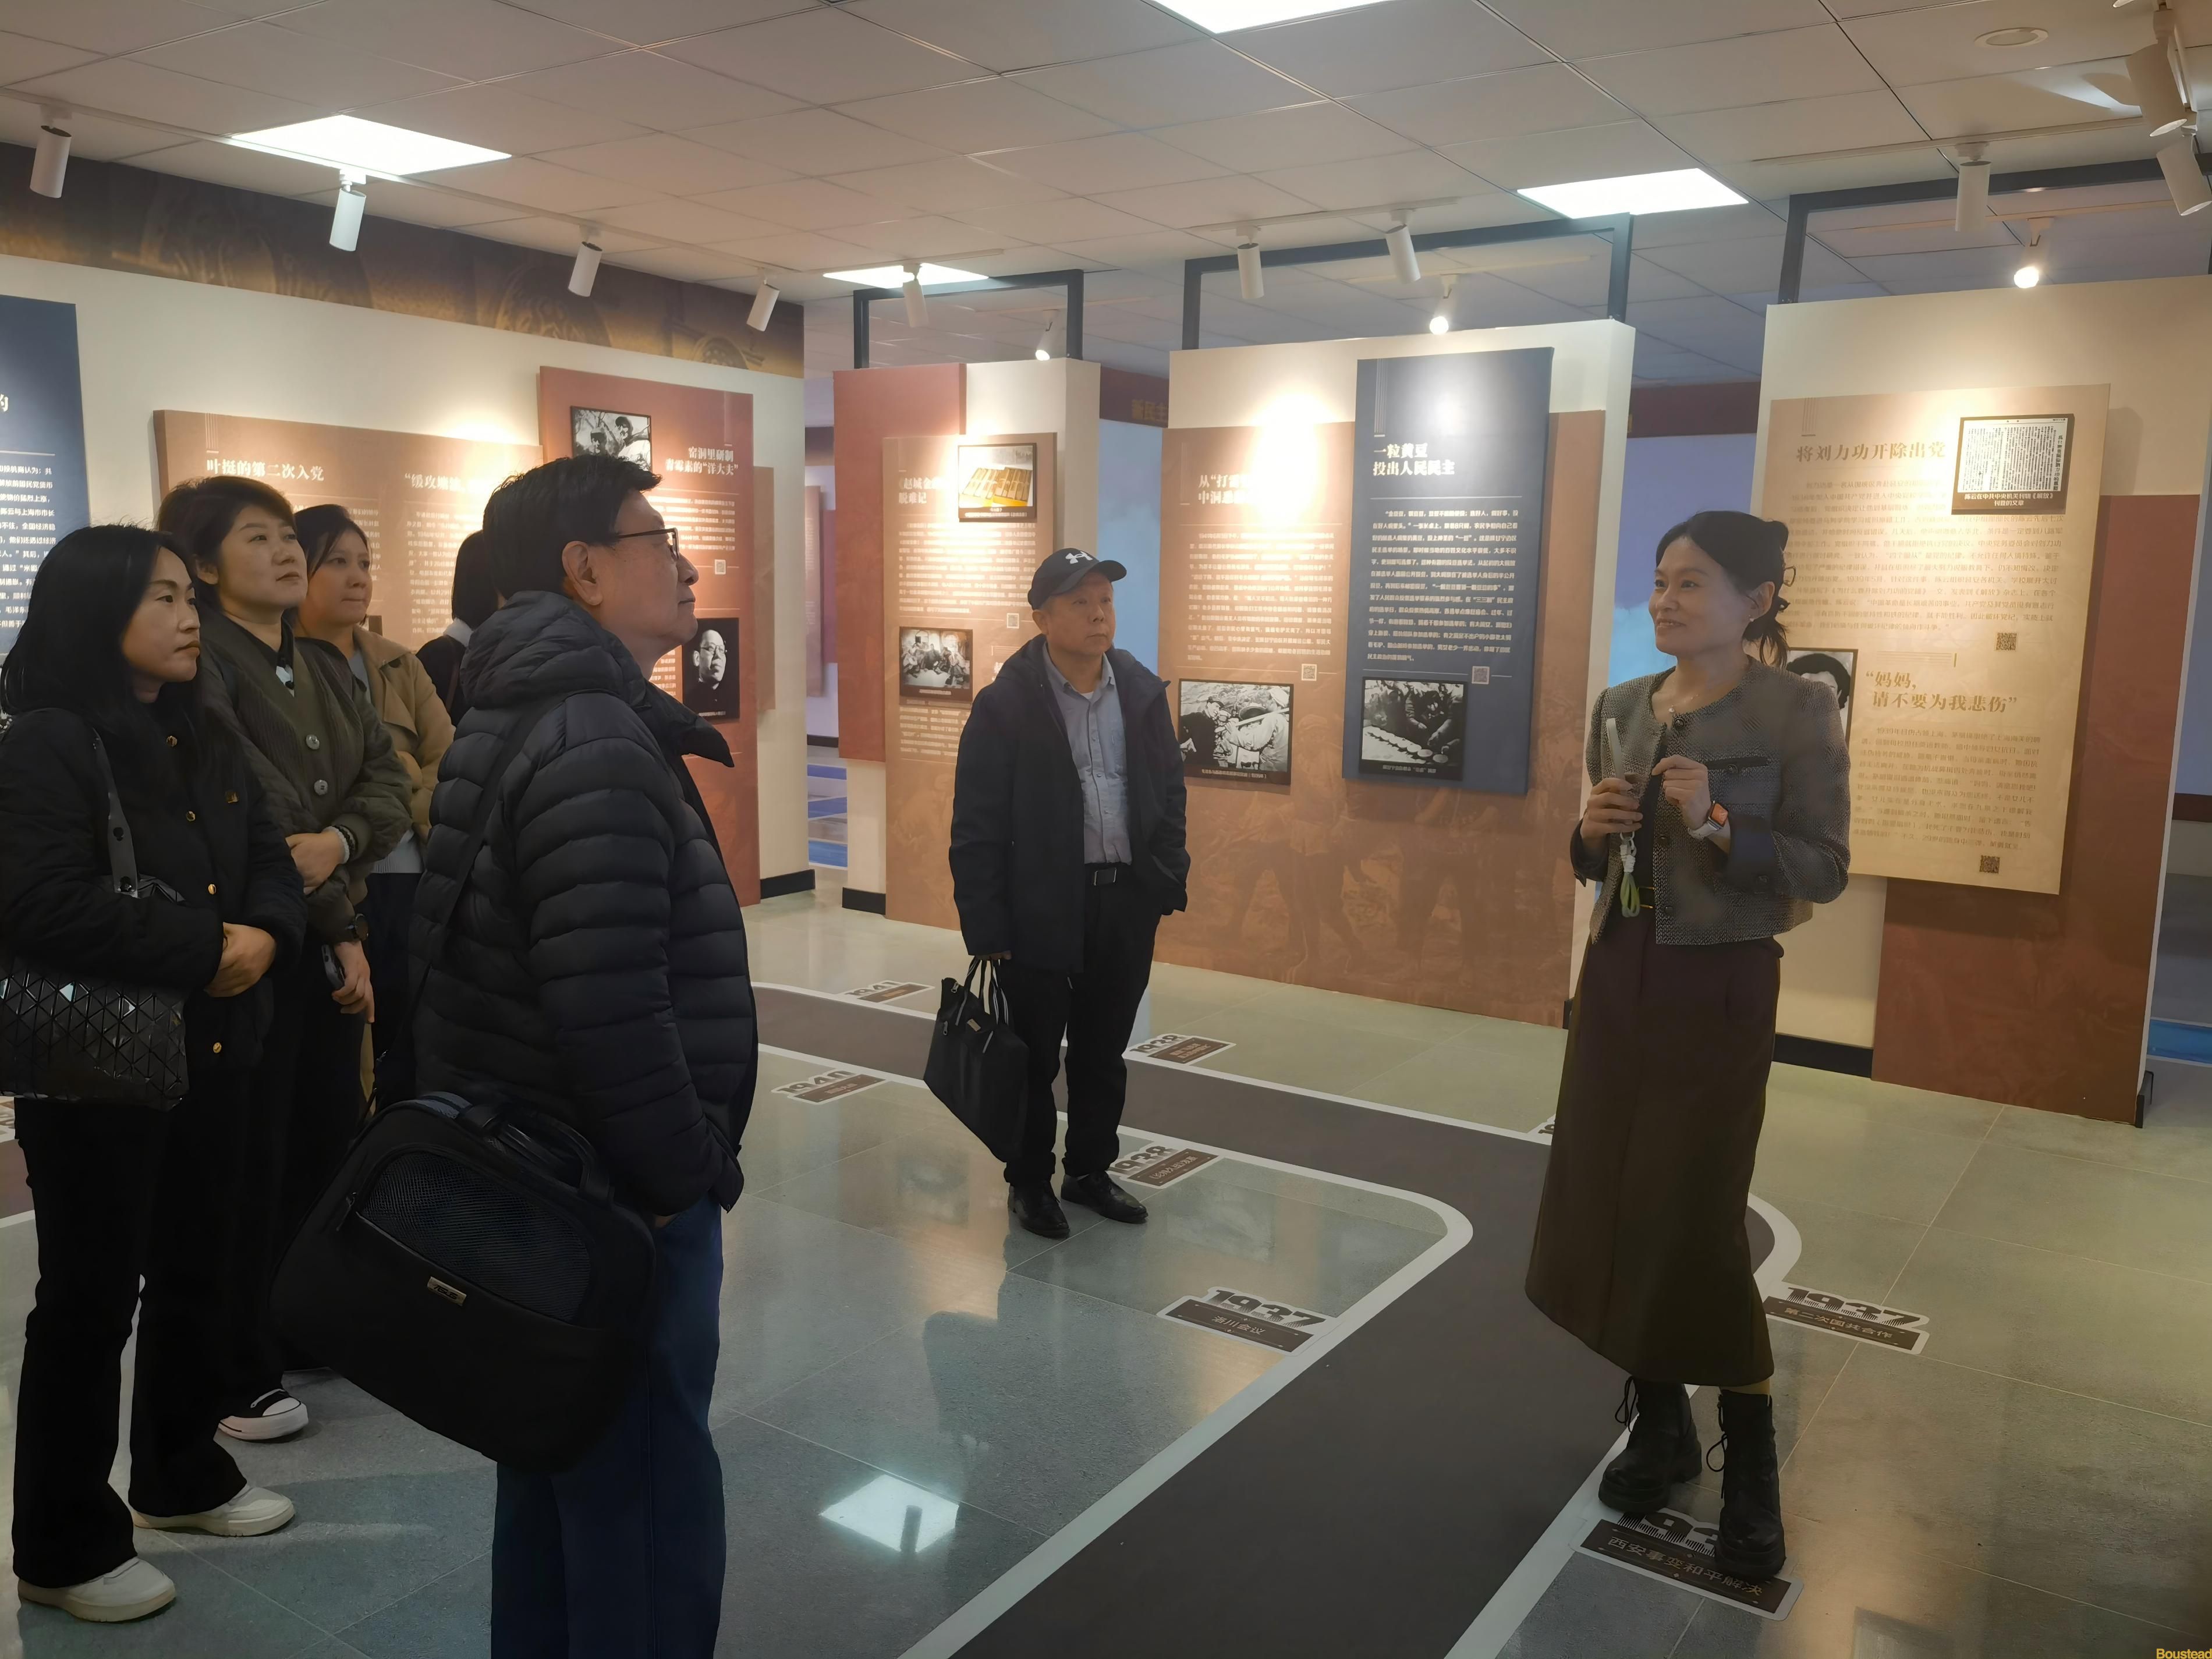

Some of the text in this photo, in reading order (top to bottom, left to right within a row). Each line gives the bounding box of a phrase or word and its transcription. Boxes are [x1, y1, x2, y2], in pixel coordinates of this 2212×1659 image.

[1374, 442, 1428, 459] 一粒黄豆
[1796, 441, 1945, 462] 将刘力功开除出党
[207, 459, 324, 481] 叶挺的第二次入党
[1373, 459, 1455, 476] 投出人民民主
[1866, 671, 1916, 690] “妈妈，
[1873, 691, 2017, 713] 请不要为我悲伤”
[1206, 1289, 1327, 1329] 1937
[1786, 1287, 1920, 1328] 1937
[1212, 1315, 1267, 1335] 洛川会议
[1784, 1307, 1893, 1338] 第二次国共合作
[1607, 1536, 1763, 1596] 西安事变和平解决
